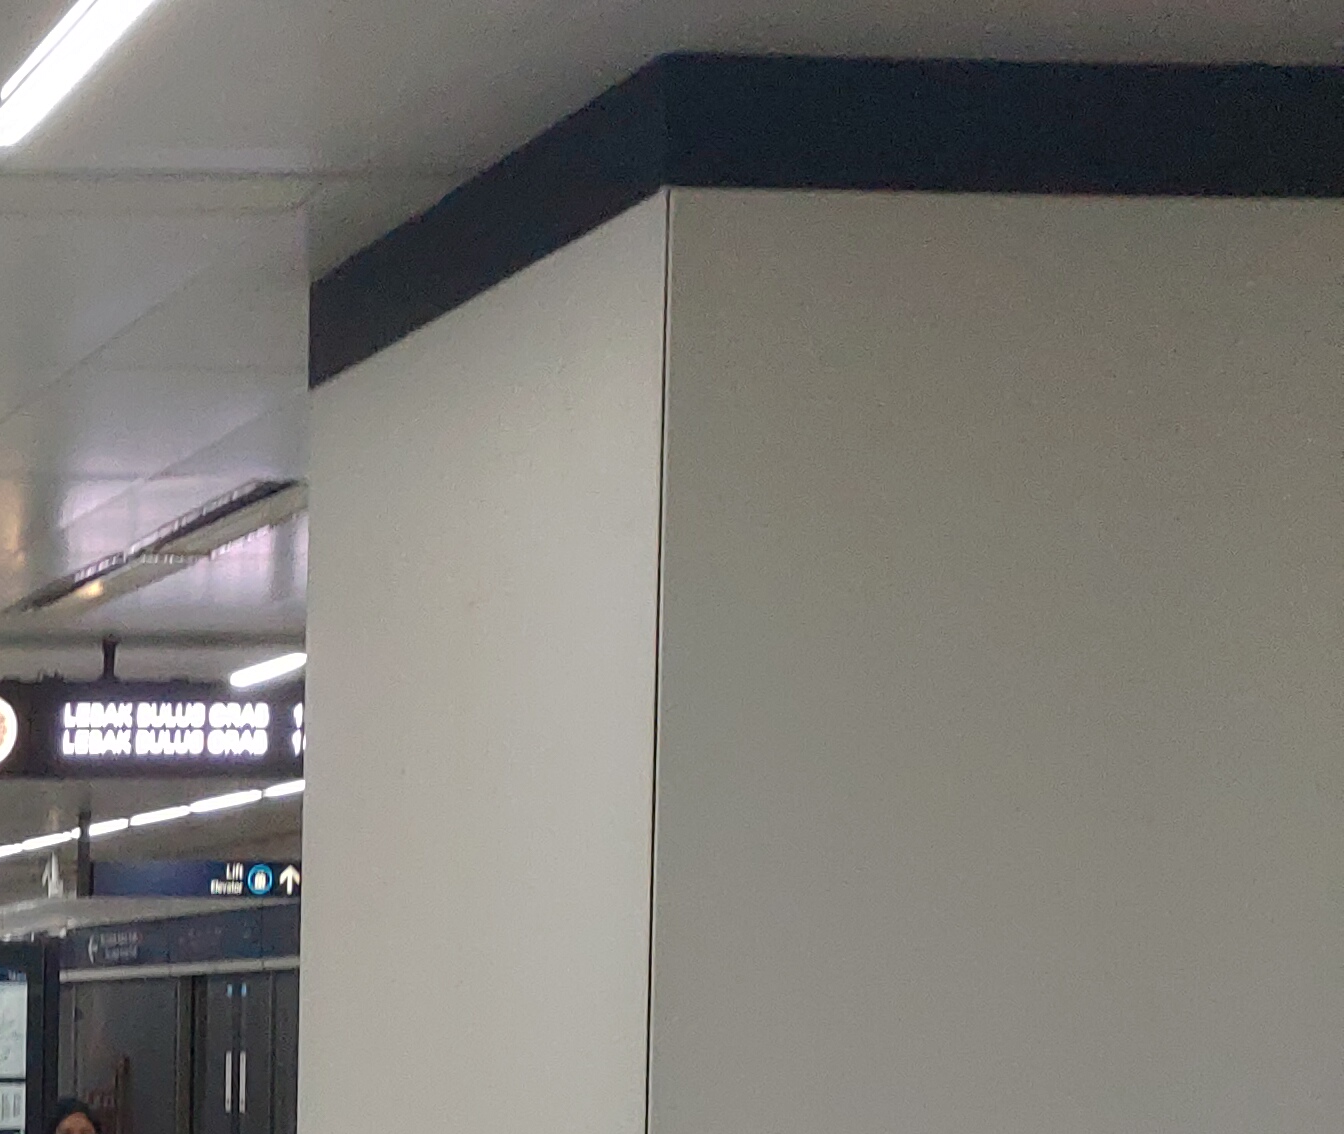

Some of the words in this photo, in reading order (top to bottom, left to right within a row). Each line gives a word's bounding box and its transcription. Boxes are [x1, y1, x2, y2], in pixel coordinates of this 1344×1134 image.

[63, 702, 133, 728] LEBAK
[136, 702, 205, 728] BULUS
[209, 702, 270, 728] GRAB
[62, 729, 132, 755] LEBAK
[135, 729, 205, 755] BULUS
[207, 729, 268, 755] GRAB
[226, 862, 244, 880] Lift
